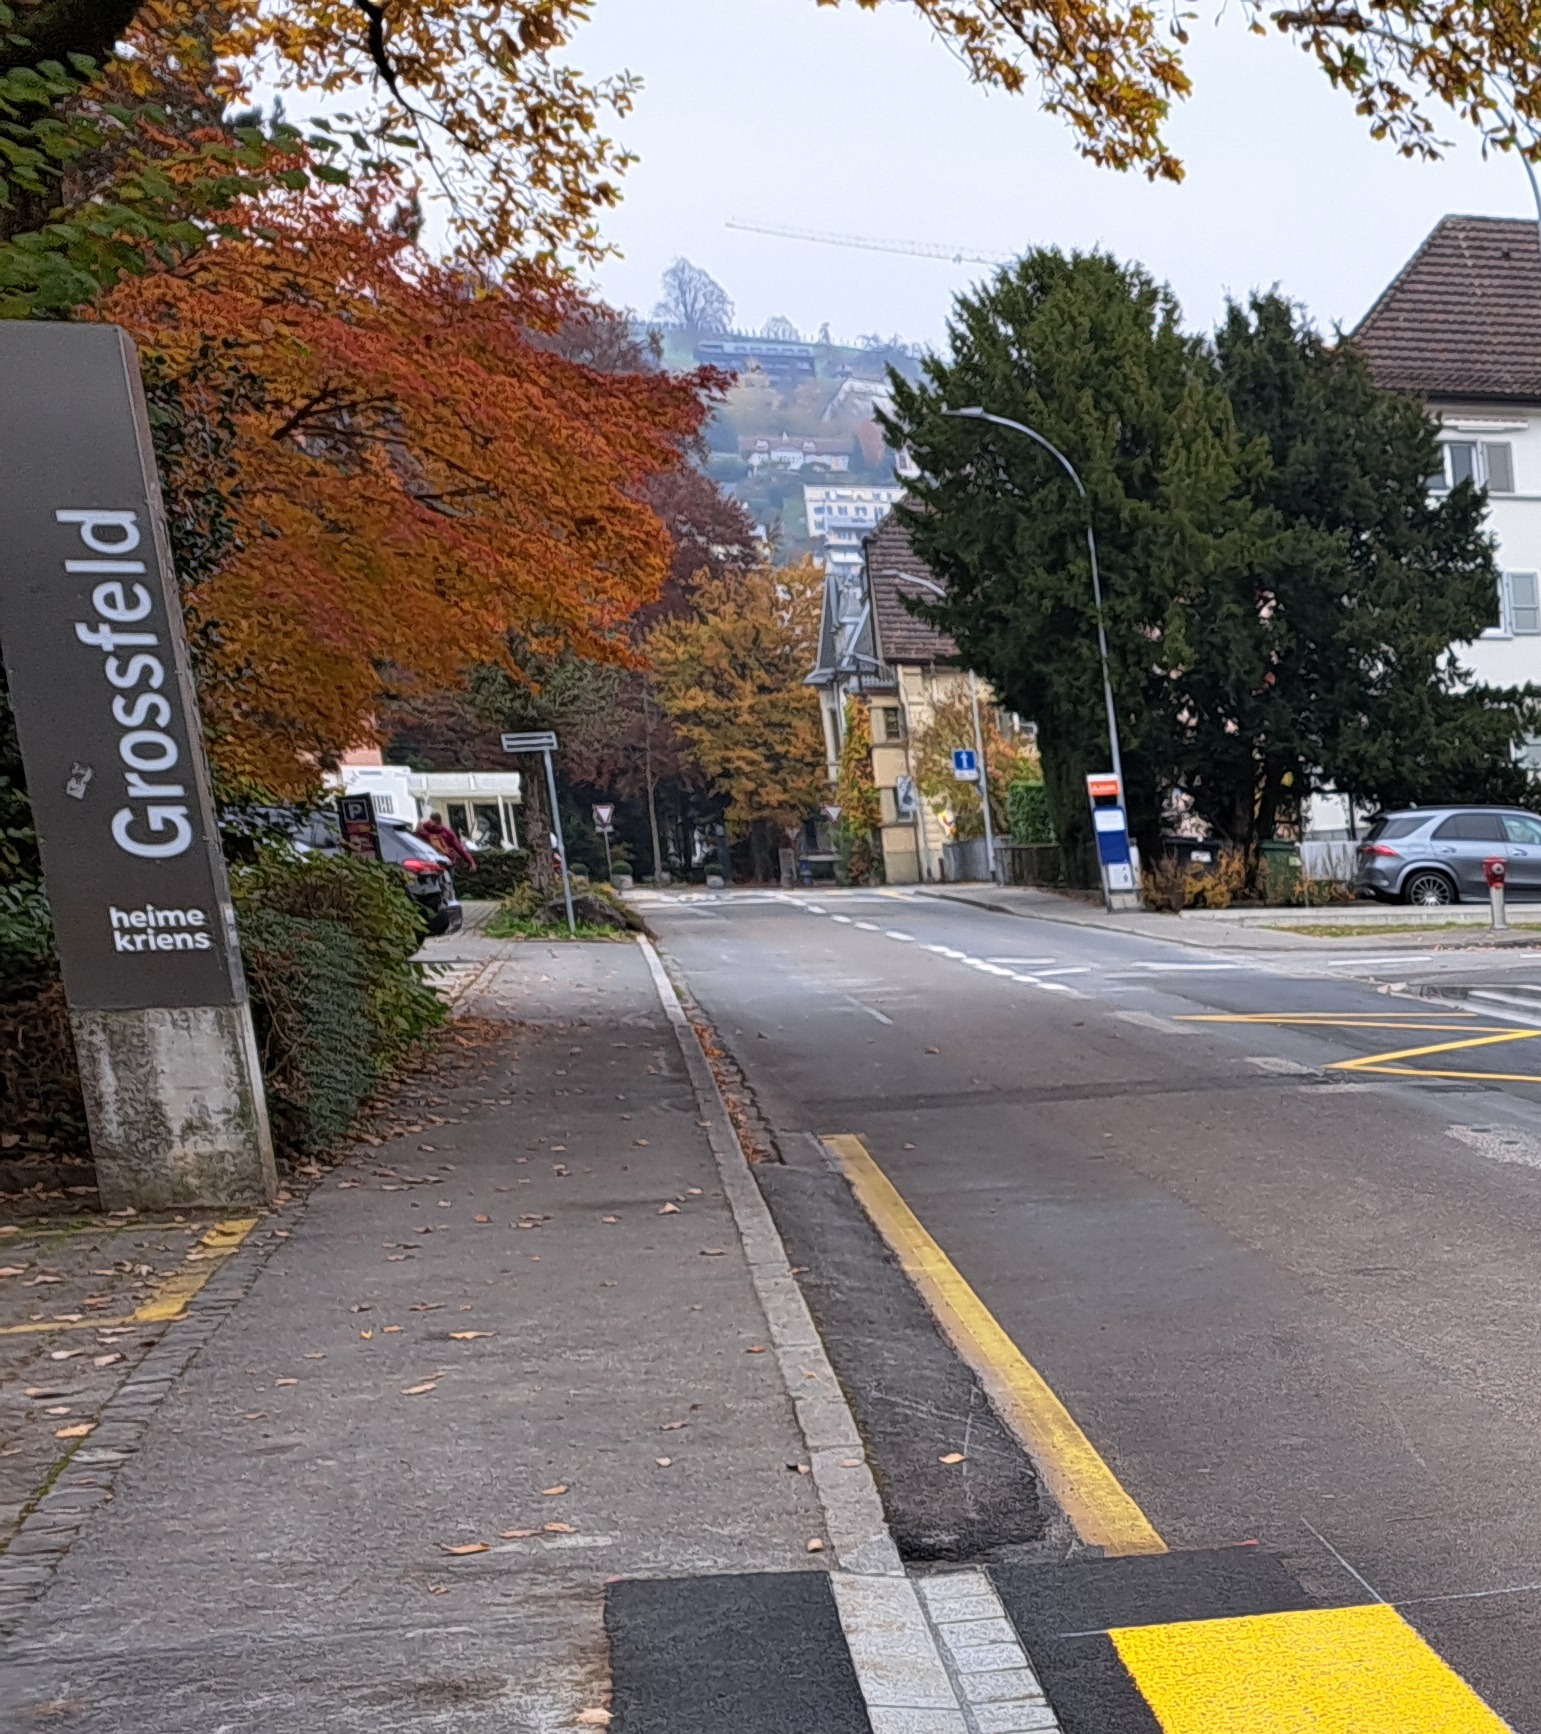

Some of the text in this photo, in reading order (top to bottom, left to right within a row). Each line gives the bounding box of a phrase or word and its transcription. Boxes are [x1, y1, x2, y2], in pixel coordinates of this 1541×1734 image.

[55, 509, 192, 859] Grossfeld
[350, 803, 363, 817] P
[109, 903, 206, 928] heime
[113, 928, 212, 952] kriens
